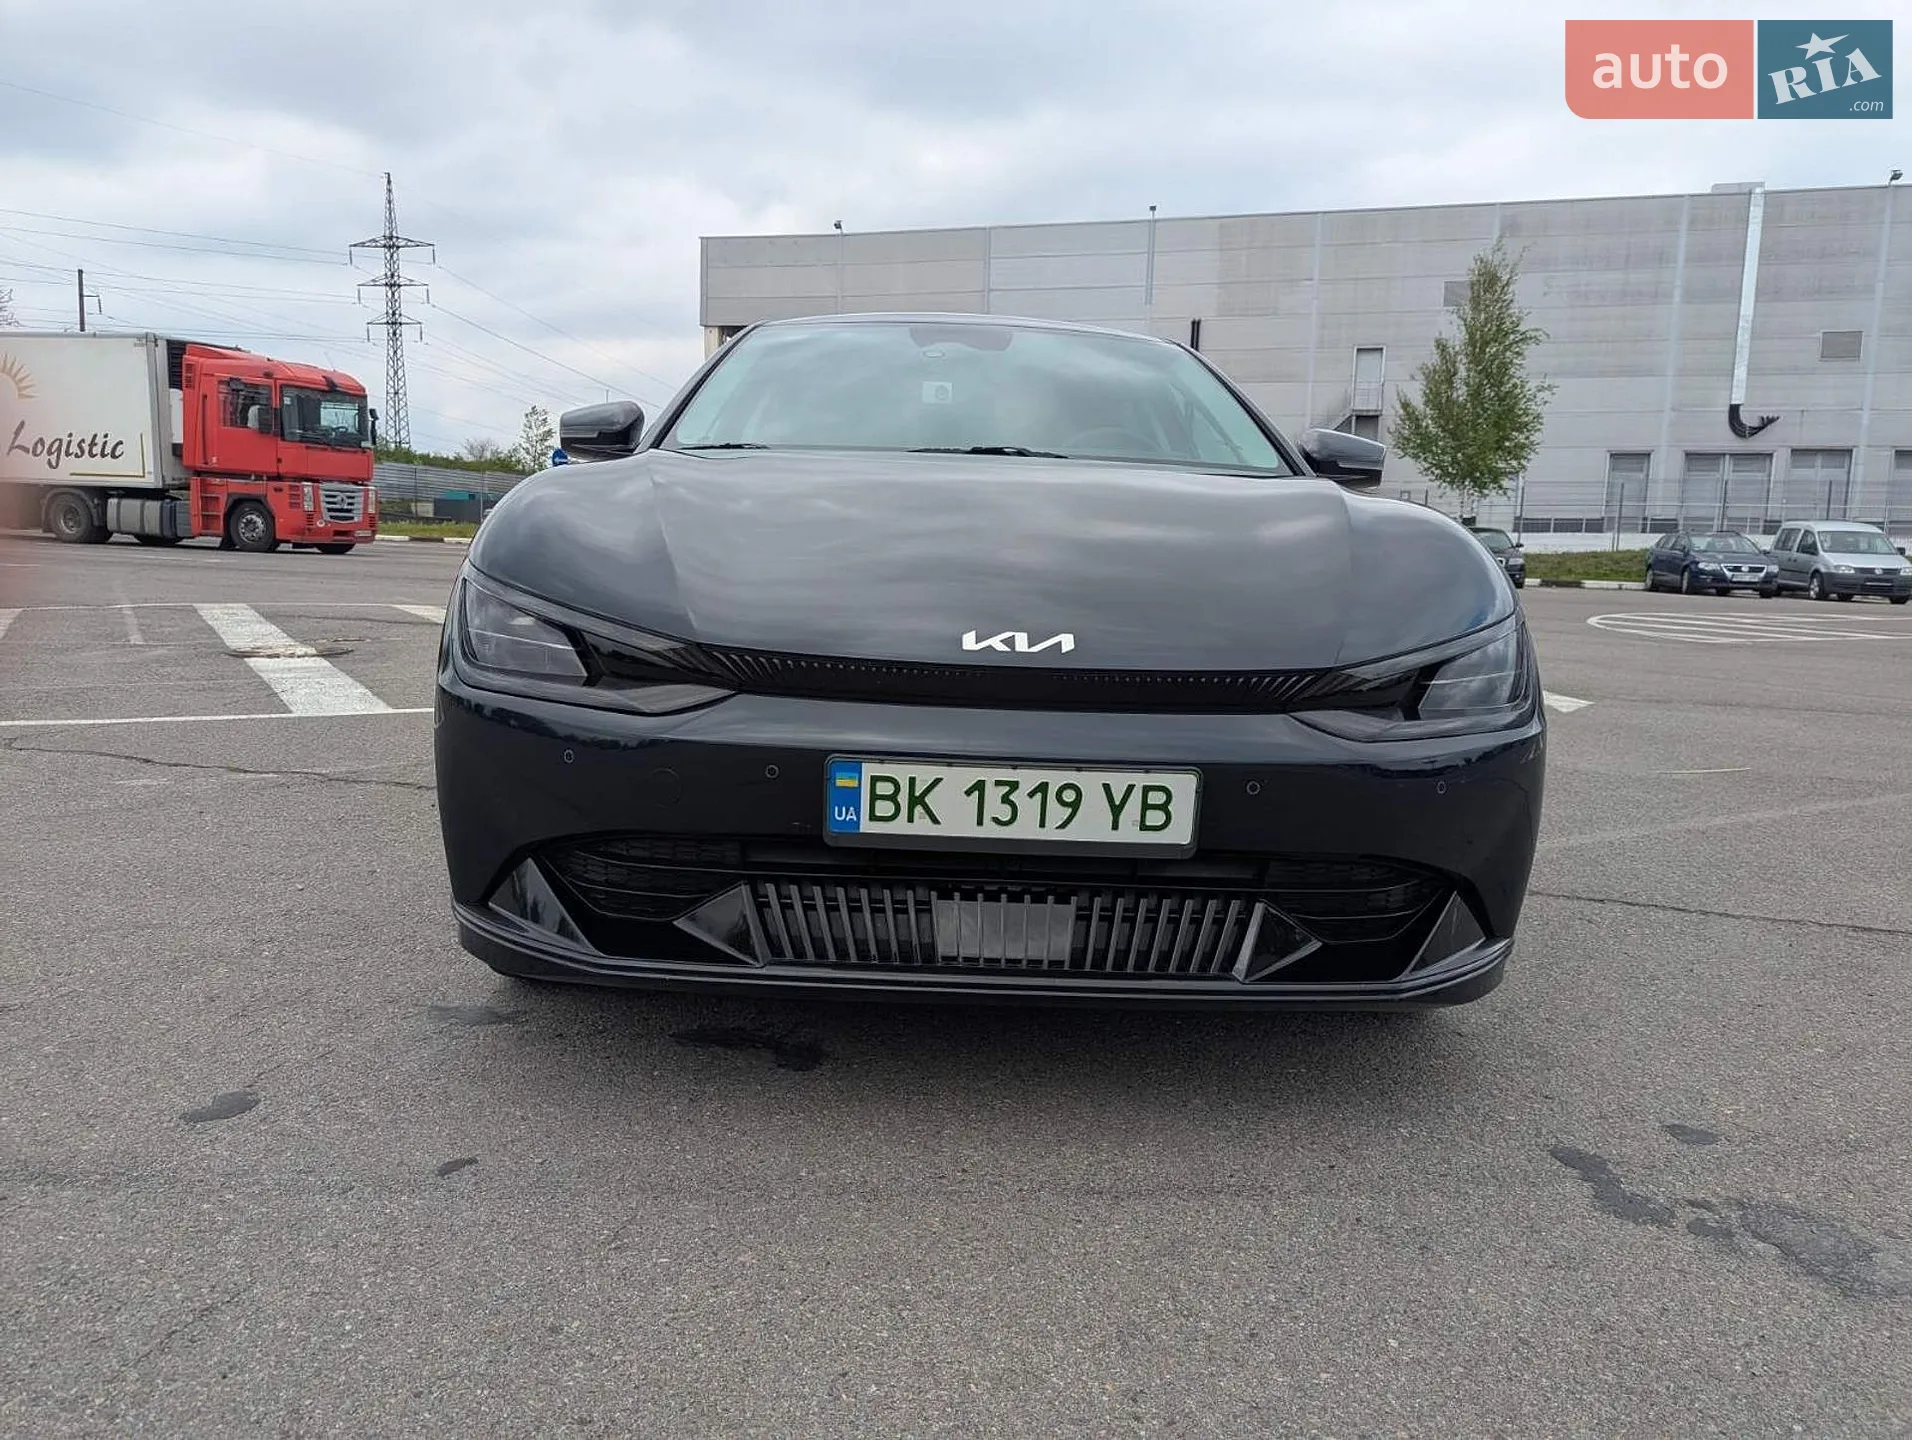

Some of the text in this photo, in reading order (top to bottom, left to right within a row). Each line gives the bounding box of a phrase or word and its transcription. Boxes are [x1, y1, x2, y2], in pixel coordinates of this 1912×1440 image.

[7, 420, 124, 470] Logistic
[962, 630, 1075, 653] KIA
[835, 806, 857, 821] UA
[868, 774, 1174, 832] BK 1319 YB
